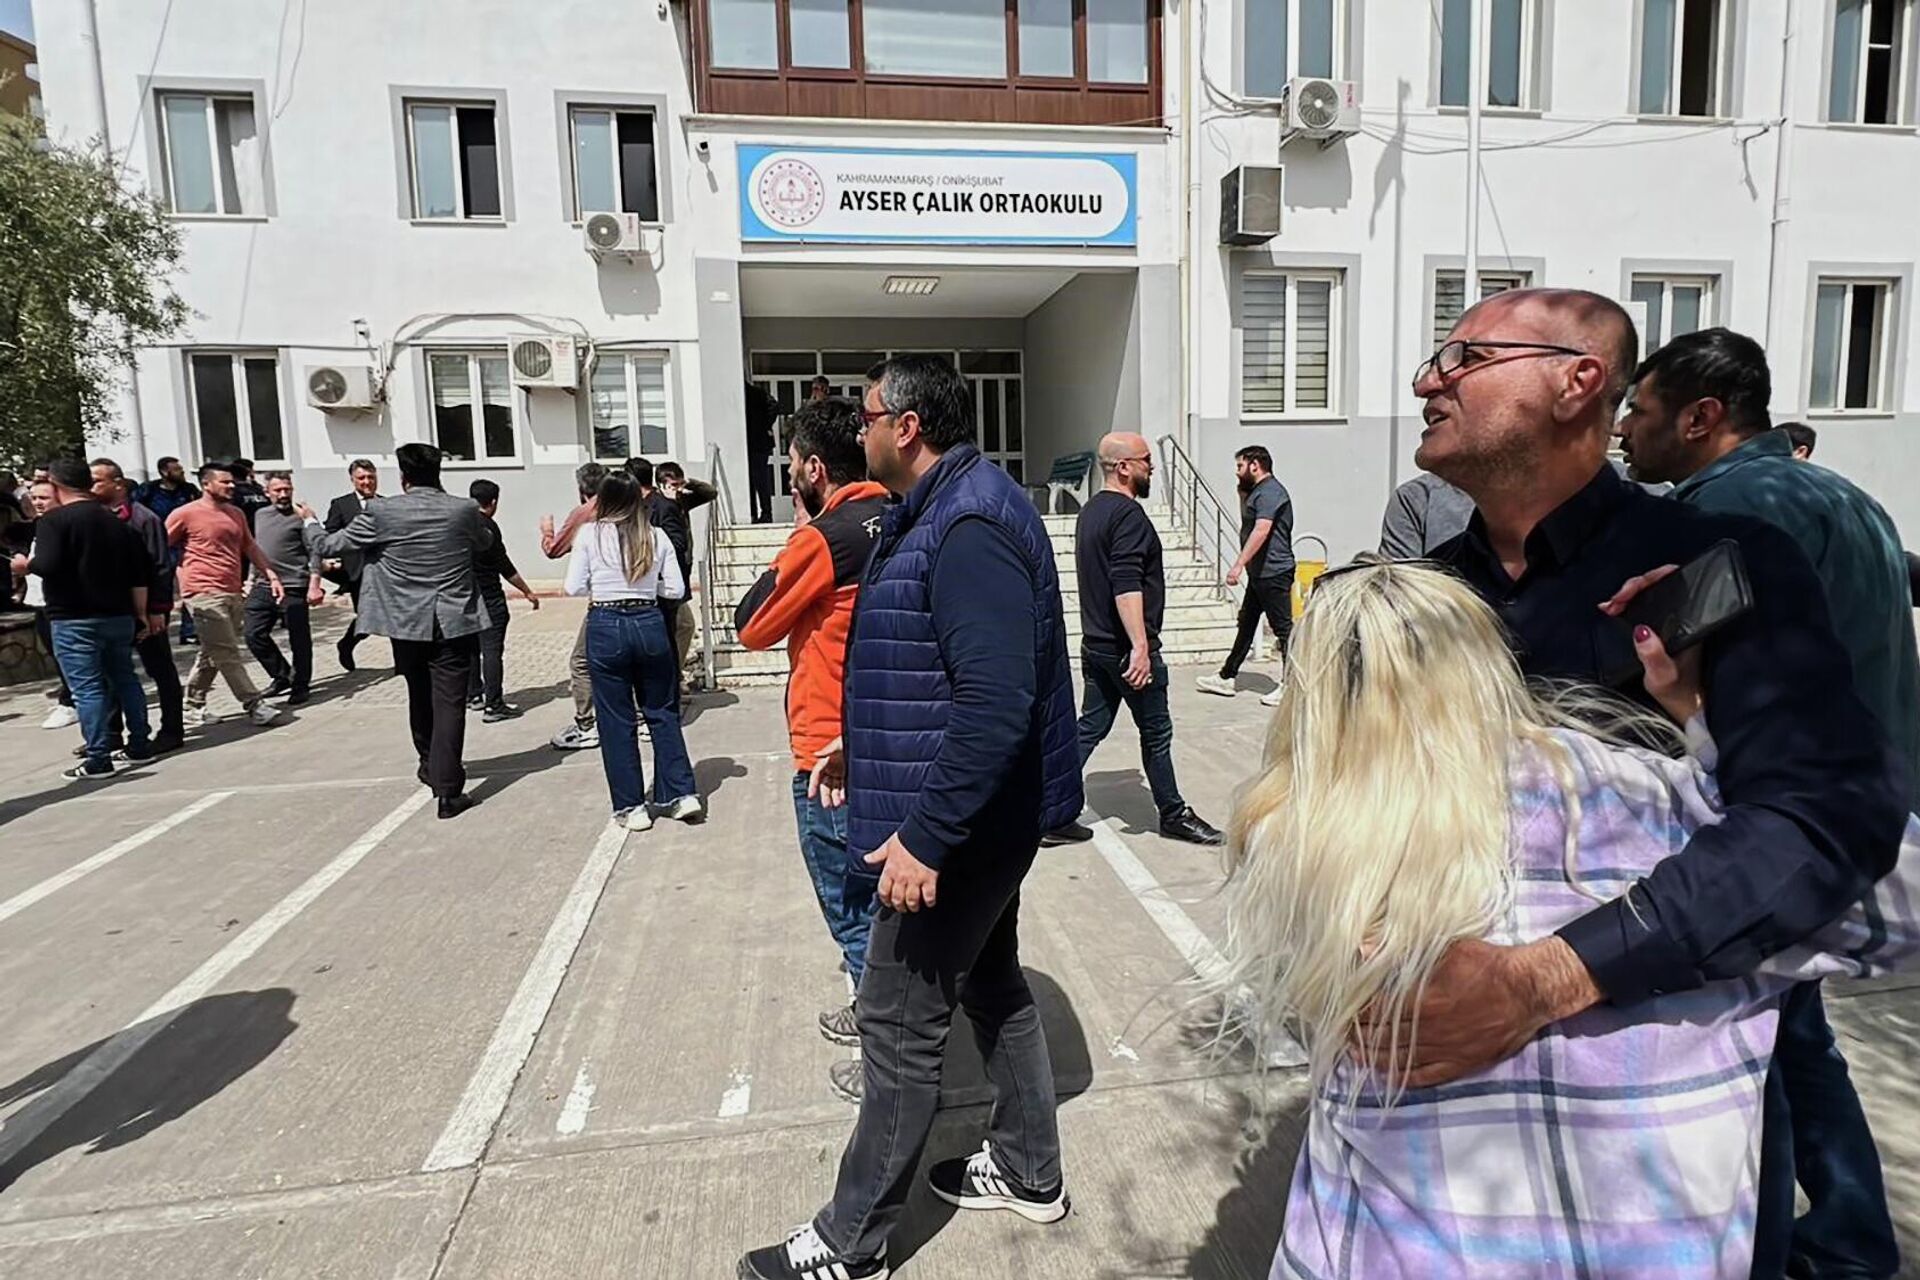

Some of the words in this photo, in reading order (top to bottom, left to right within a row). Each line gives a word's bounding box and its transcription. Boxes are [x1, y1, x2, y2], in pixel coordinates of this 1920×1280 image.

[836, 173, 934, 188] KAHRAMANMARAŞ
[839, 190, 907, 212] AYSER
[912, 191, 975, 216] ÇALIK
[979, 192, 1102, 214] ORTAOKULU
